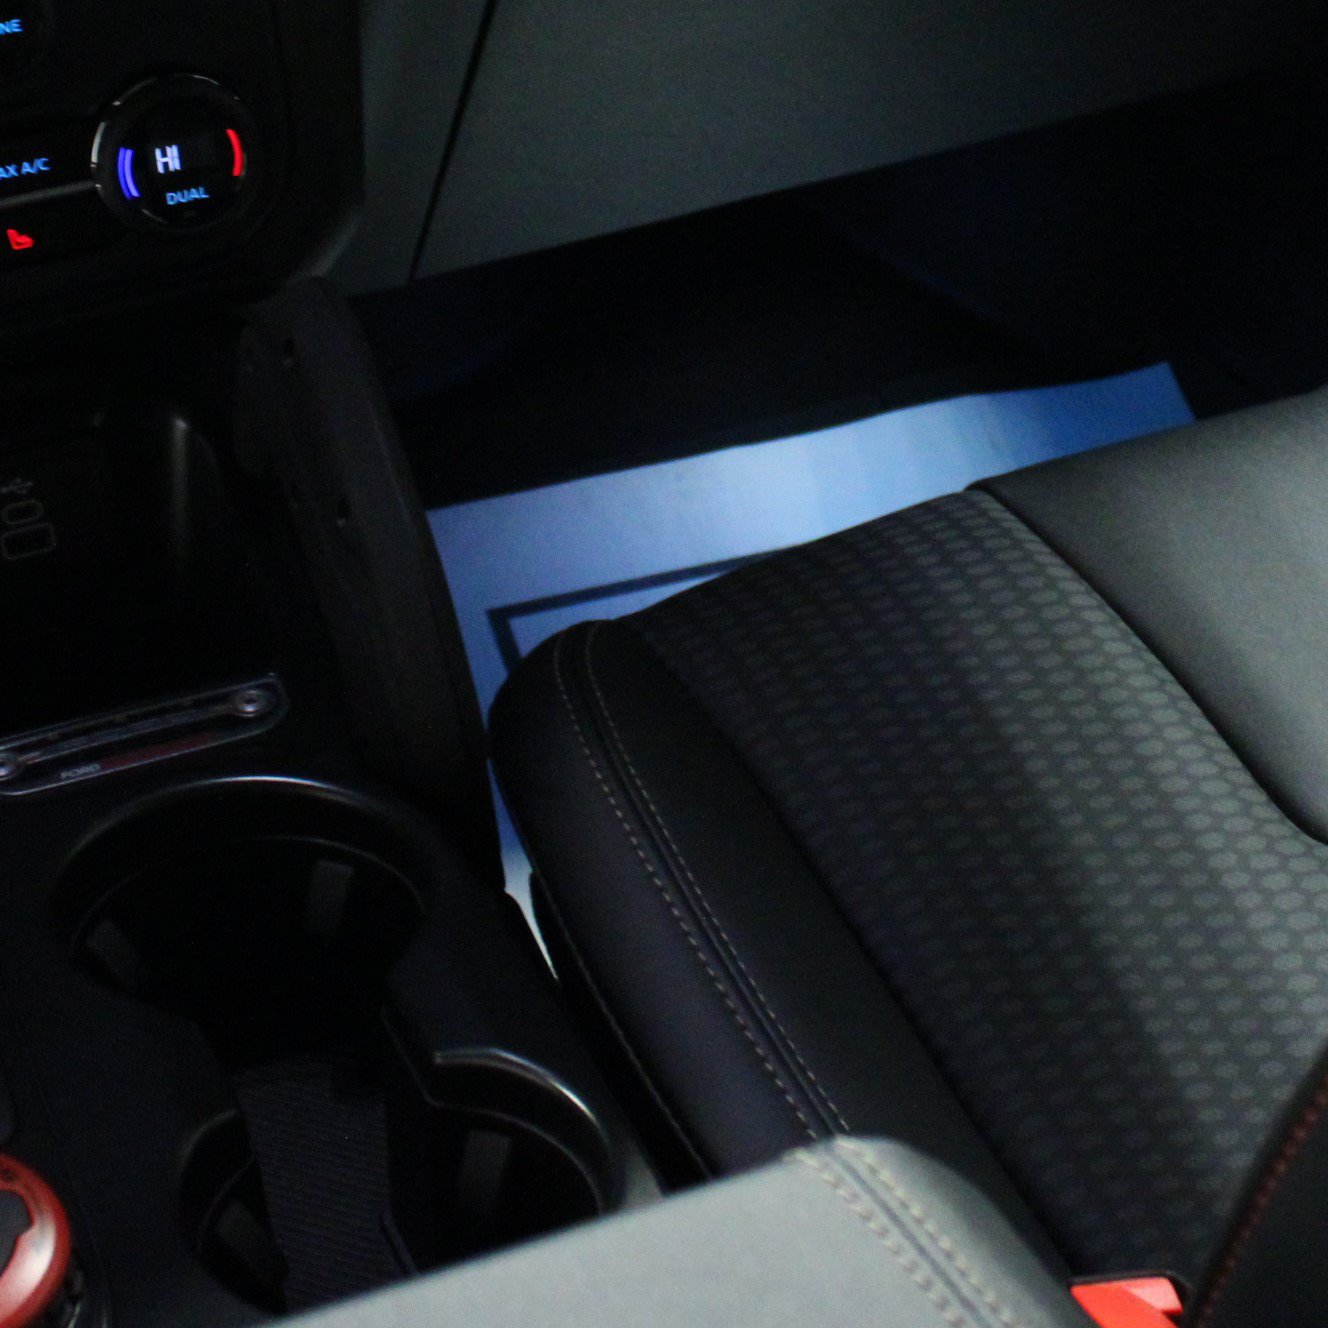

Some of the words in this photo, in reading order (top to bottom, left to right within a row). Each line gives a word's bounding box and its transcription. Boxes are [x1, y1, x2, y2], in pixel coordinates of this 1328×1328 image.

[20, 156, 51, 177] A/C
[154, 144, 181, 174] HI
[165, 186, 210, 206] DUAL
